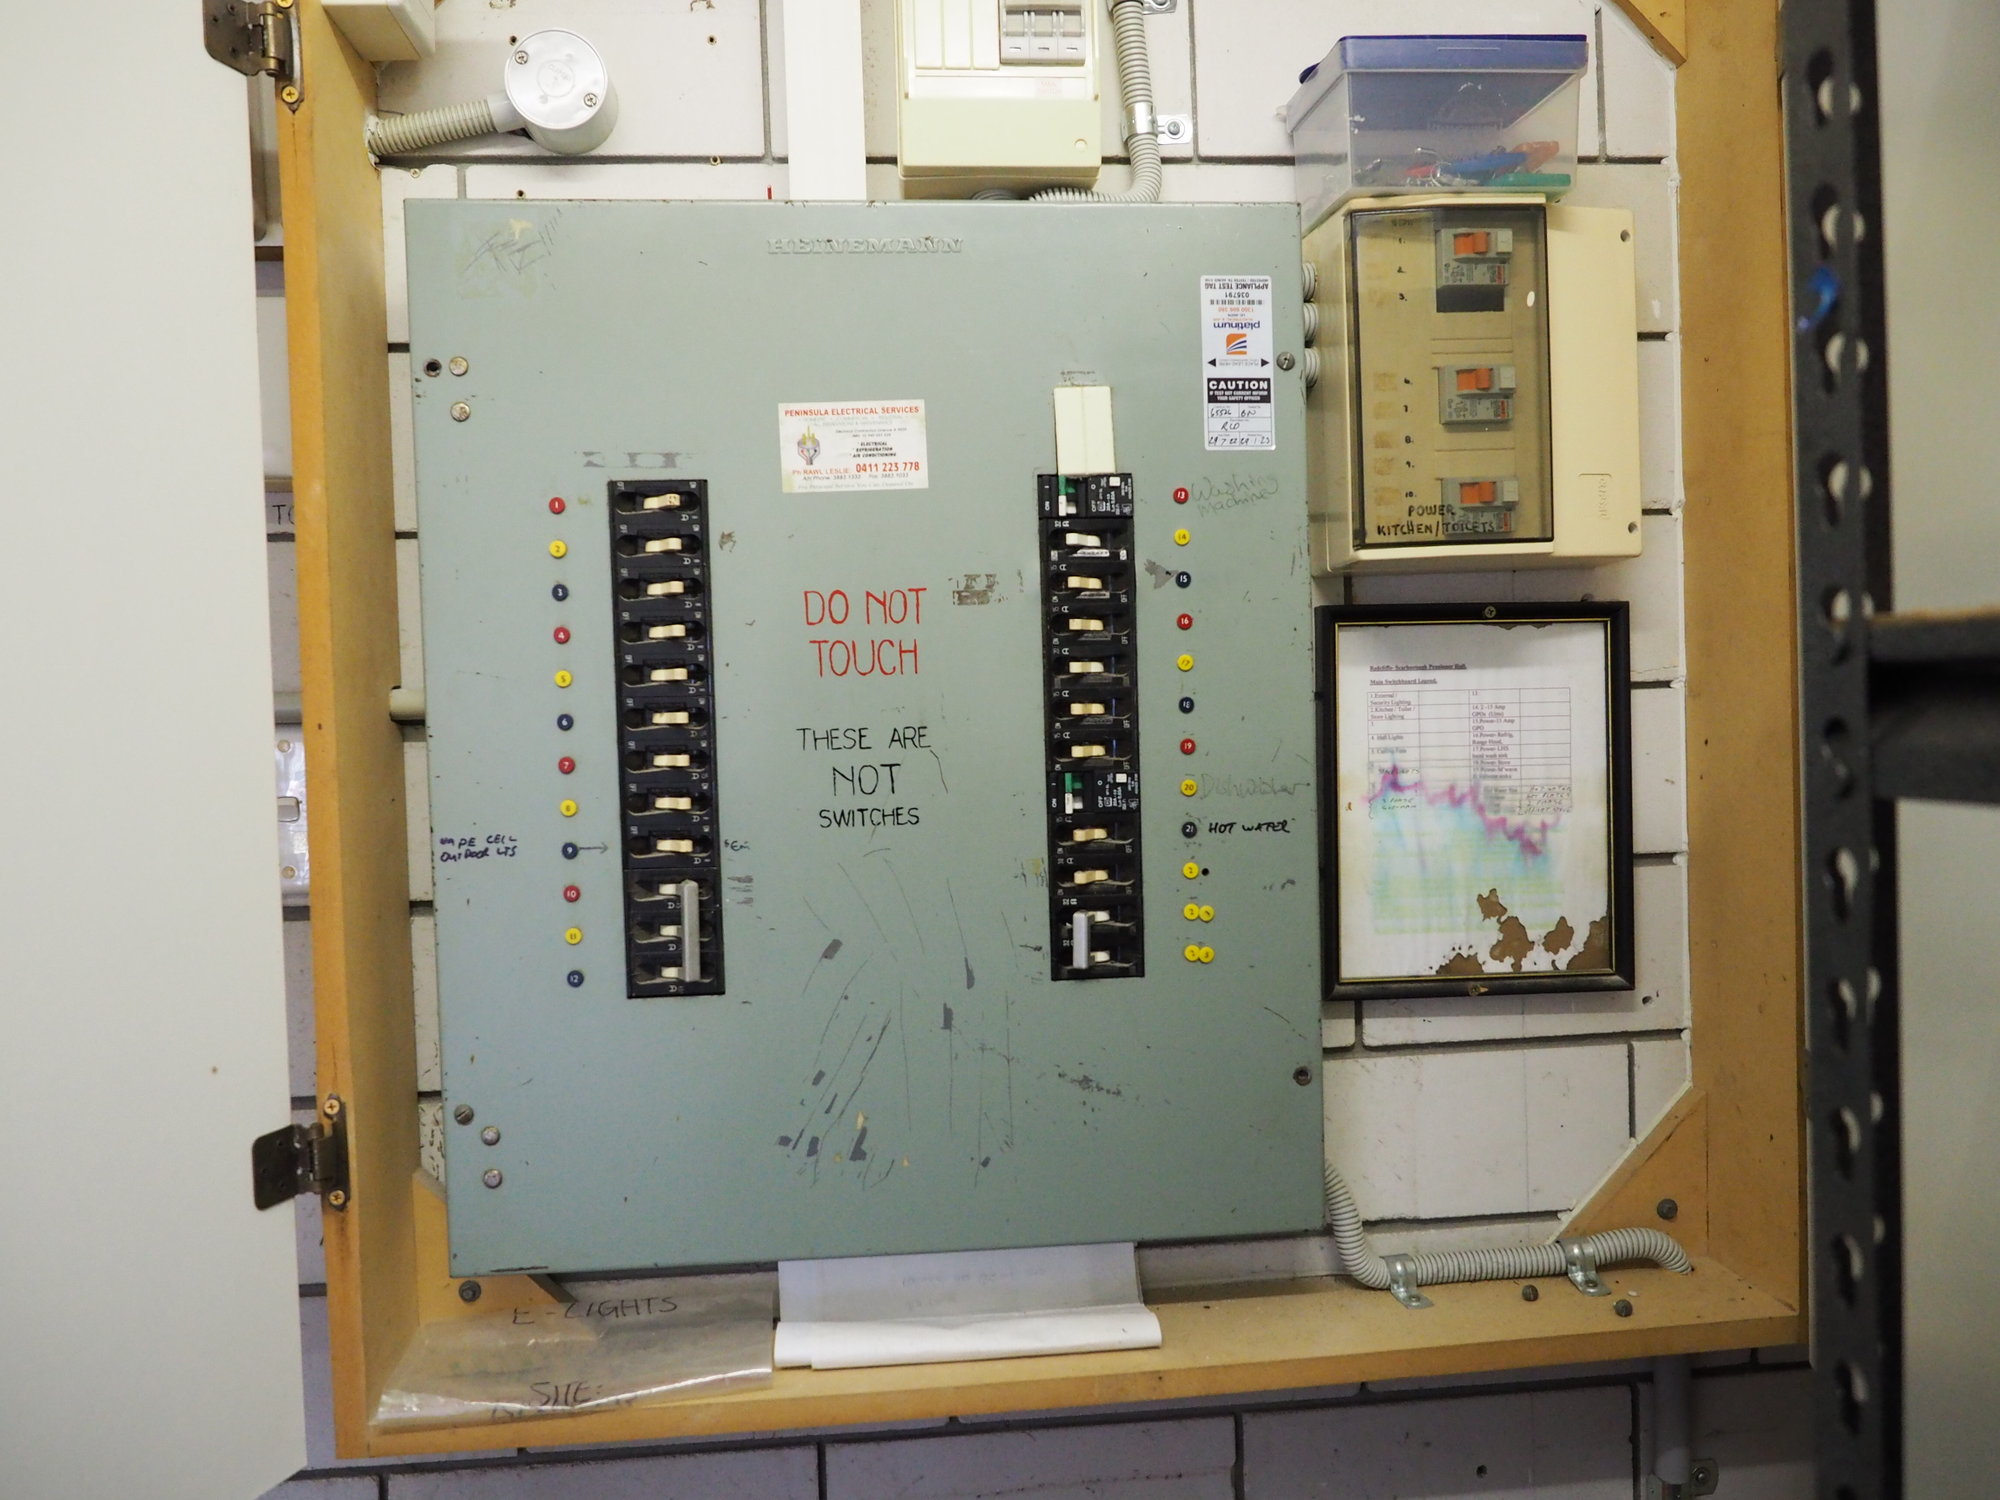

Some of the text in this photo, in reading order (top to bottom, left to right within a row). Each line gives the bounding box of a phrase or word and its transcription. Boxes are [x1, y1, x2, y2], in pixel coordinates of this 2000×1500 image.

[767, 237, 963, 255] HEINEMANN
[1204, 282, 1269, 290] APPLIANCE TEST TAG
[1213, 321, 1261, 330] platinum
[1209, 380, 1268, 390] CAUTION
[784, 406, 920, 417] PENINSULA ELECTRICAL SERVICES
[855, 463, 880, 473] 0411
[882, 462, 899, 473] 223
[903, 461, 920, 472] 778
[1408, 504, 1457, 517] POWER
[804, 588, 927, 625] DO NOT
[809, 639, 918, 678] TOUCH
[796, 726, 931, 750] THESE ARE
[832, 763, 901, 796] NOT
[819, 807, 920, 828] SWITCHES
[1209, 820, 1291, 834] HOT WATER
